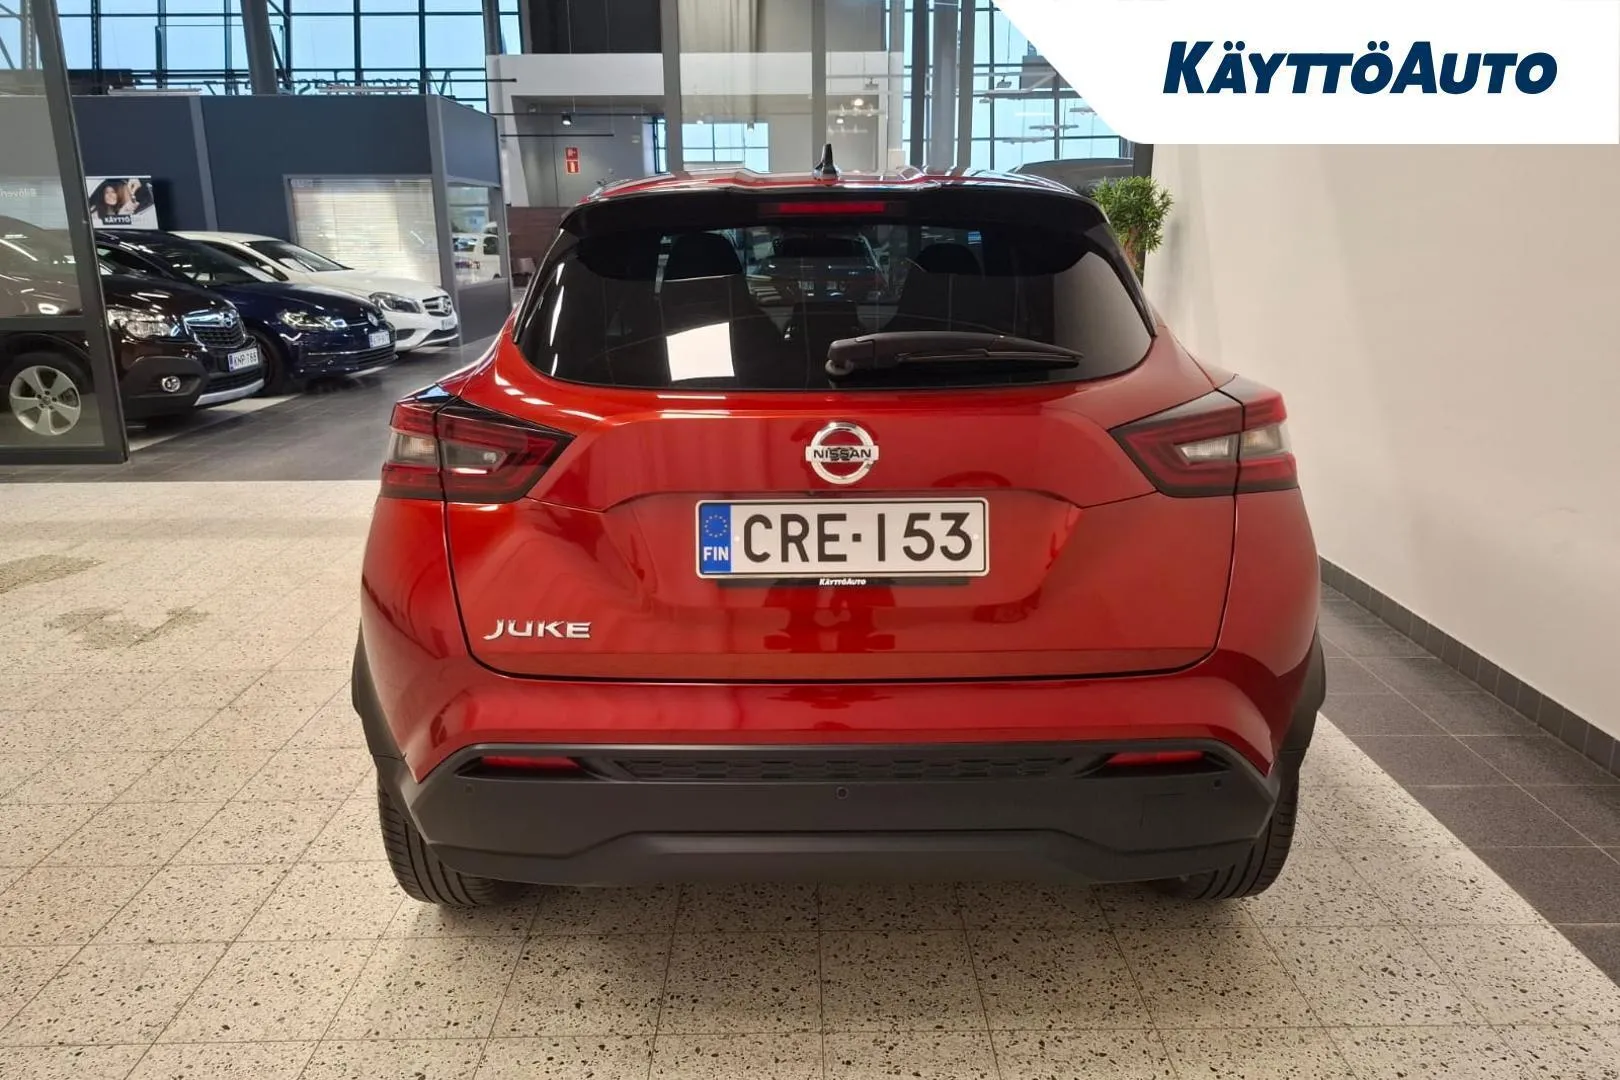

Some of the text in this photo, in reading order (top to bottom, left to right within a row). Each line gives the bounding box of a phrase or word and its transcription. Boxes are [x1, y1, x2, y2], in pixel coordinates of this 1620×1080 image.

[813, 449, 872, 460] NISSAN
[703, 546, 729, 561] FIN
[482, 619, 592, 640] JUKE
